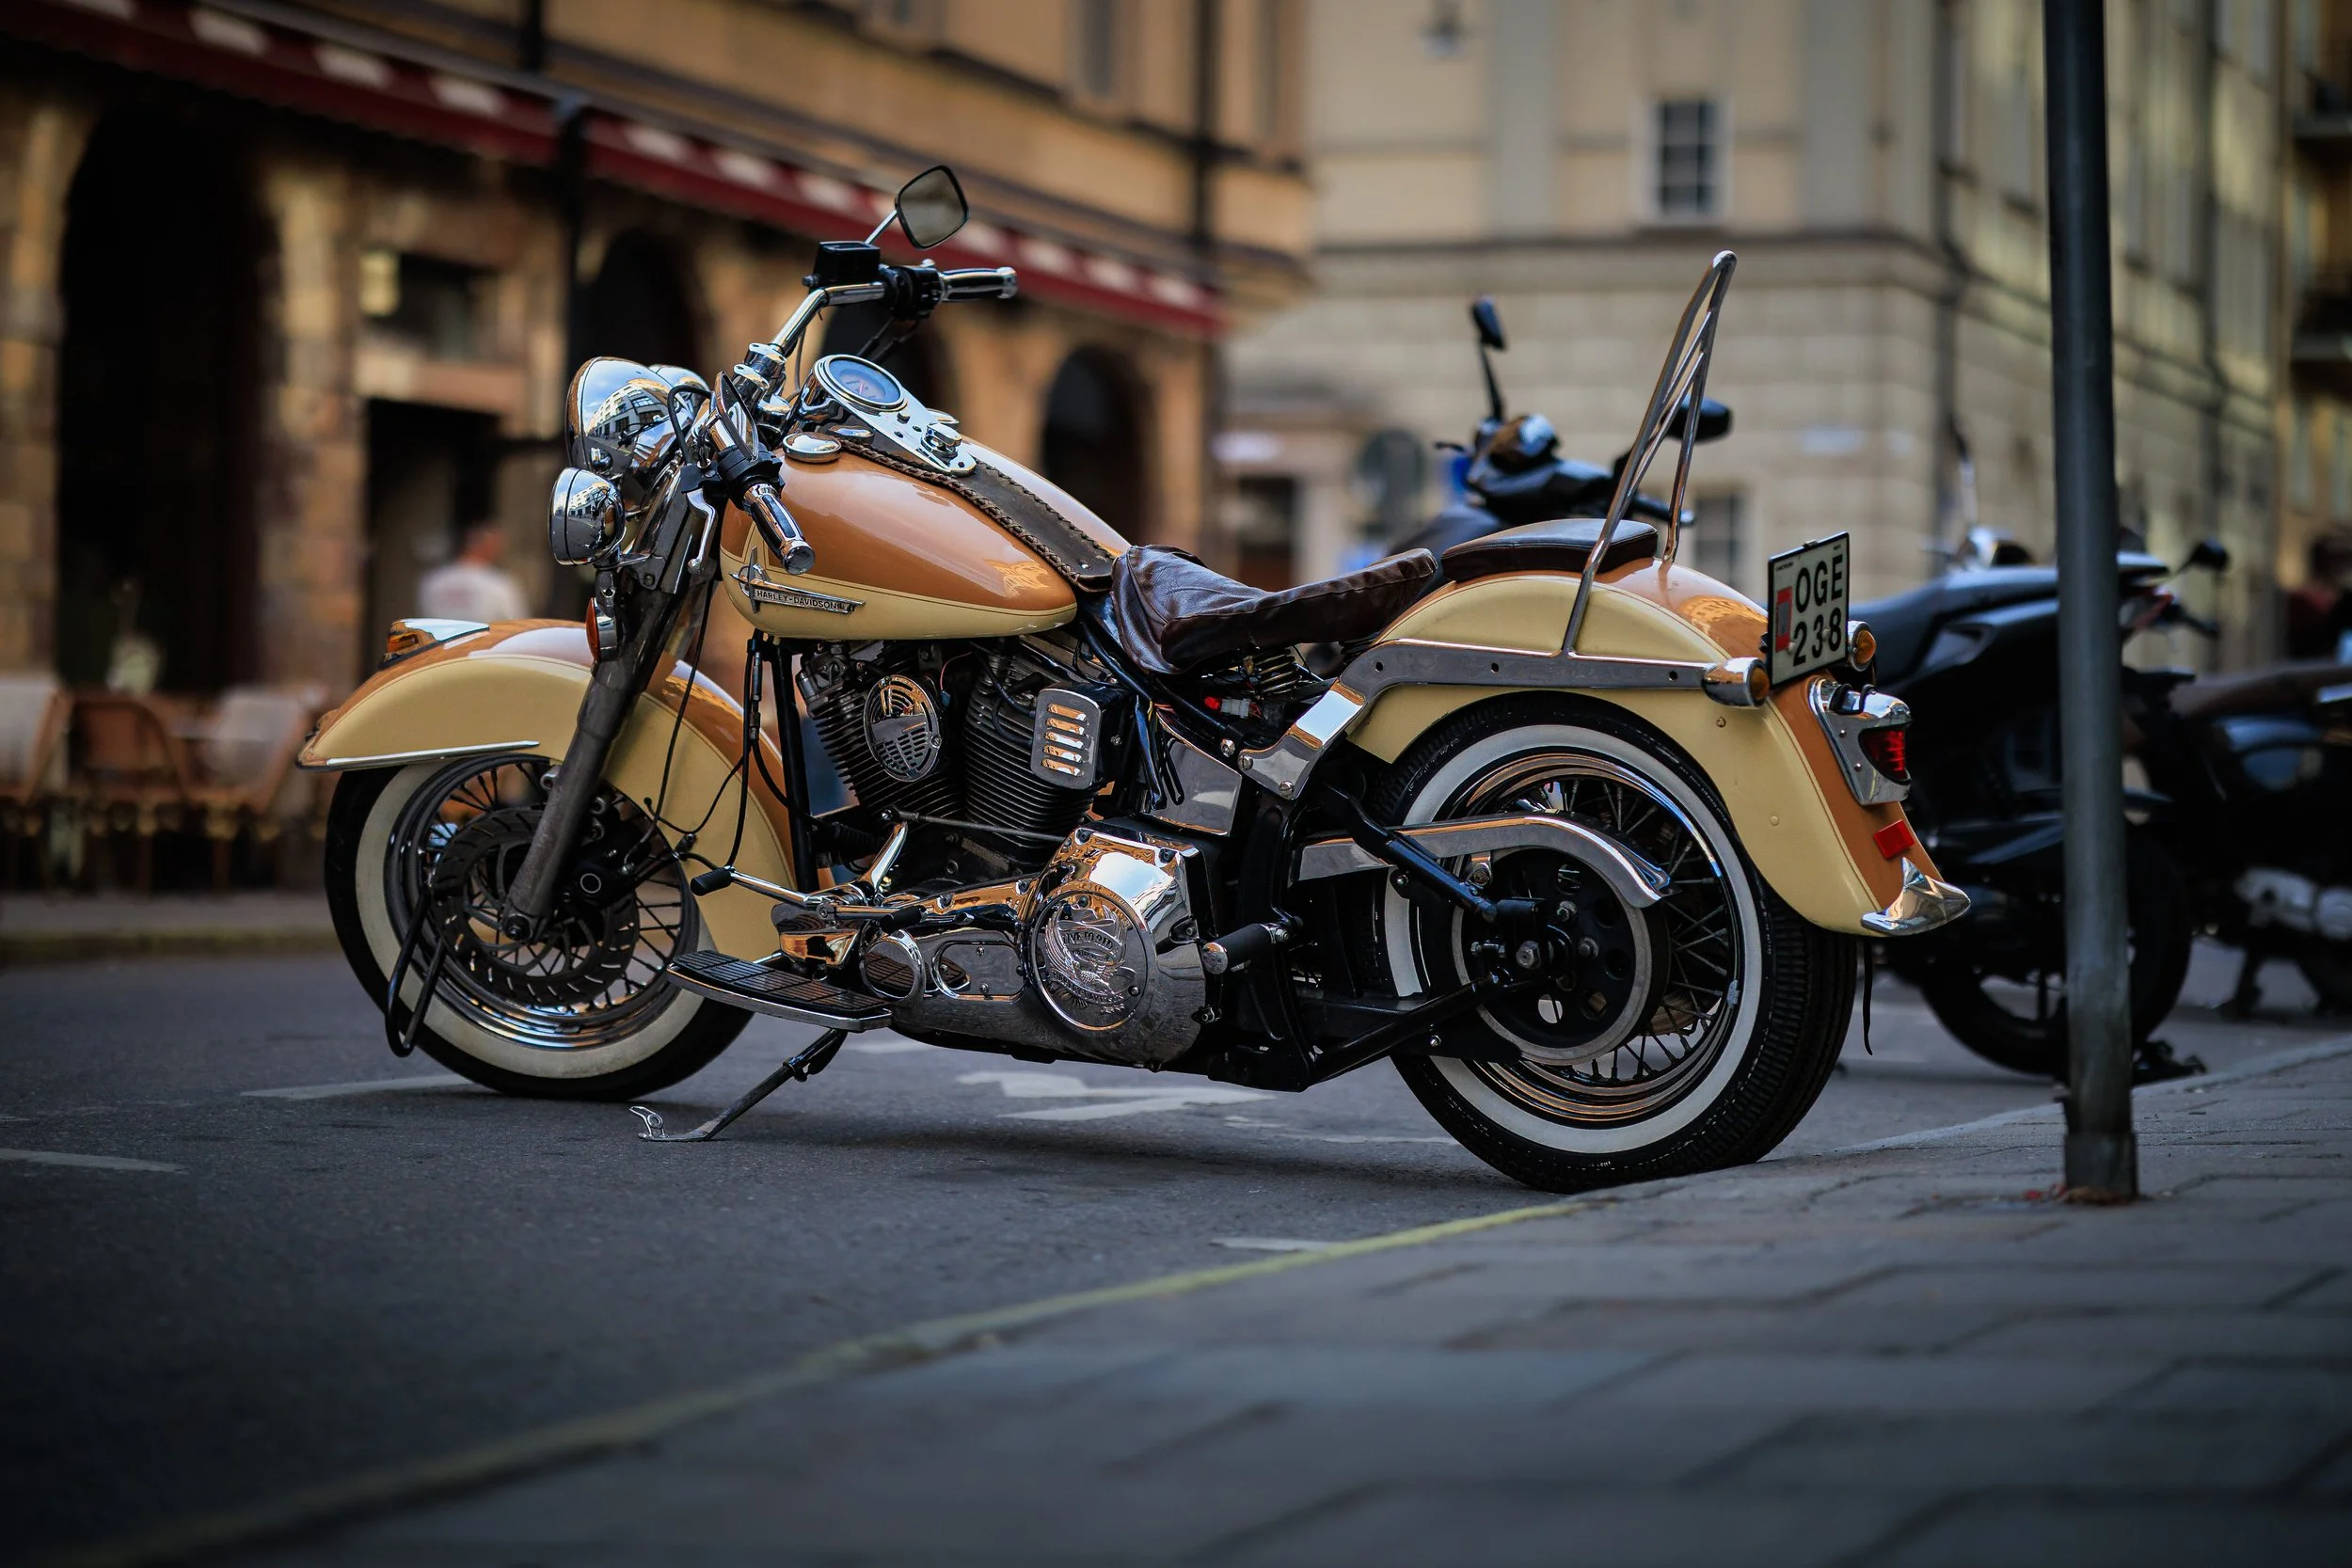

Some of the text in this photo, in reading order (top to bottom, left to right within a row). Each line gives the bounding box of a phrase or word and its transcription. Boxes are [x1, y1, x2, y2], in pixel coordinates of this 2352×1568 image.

[756, 590, 836, 609] HARLEY-DAVIDSON
[1795, 554, 1844, 613] OGE
[1793, 608, 1842, 667] 238
